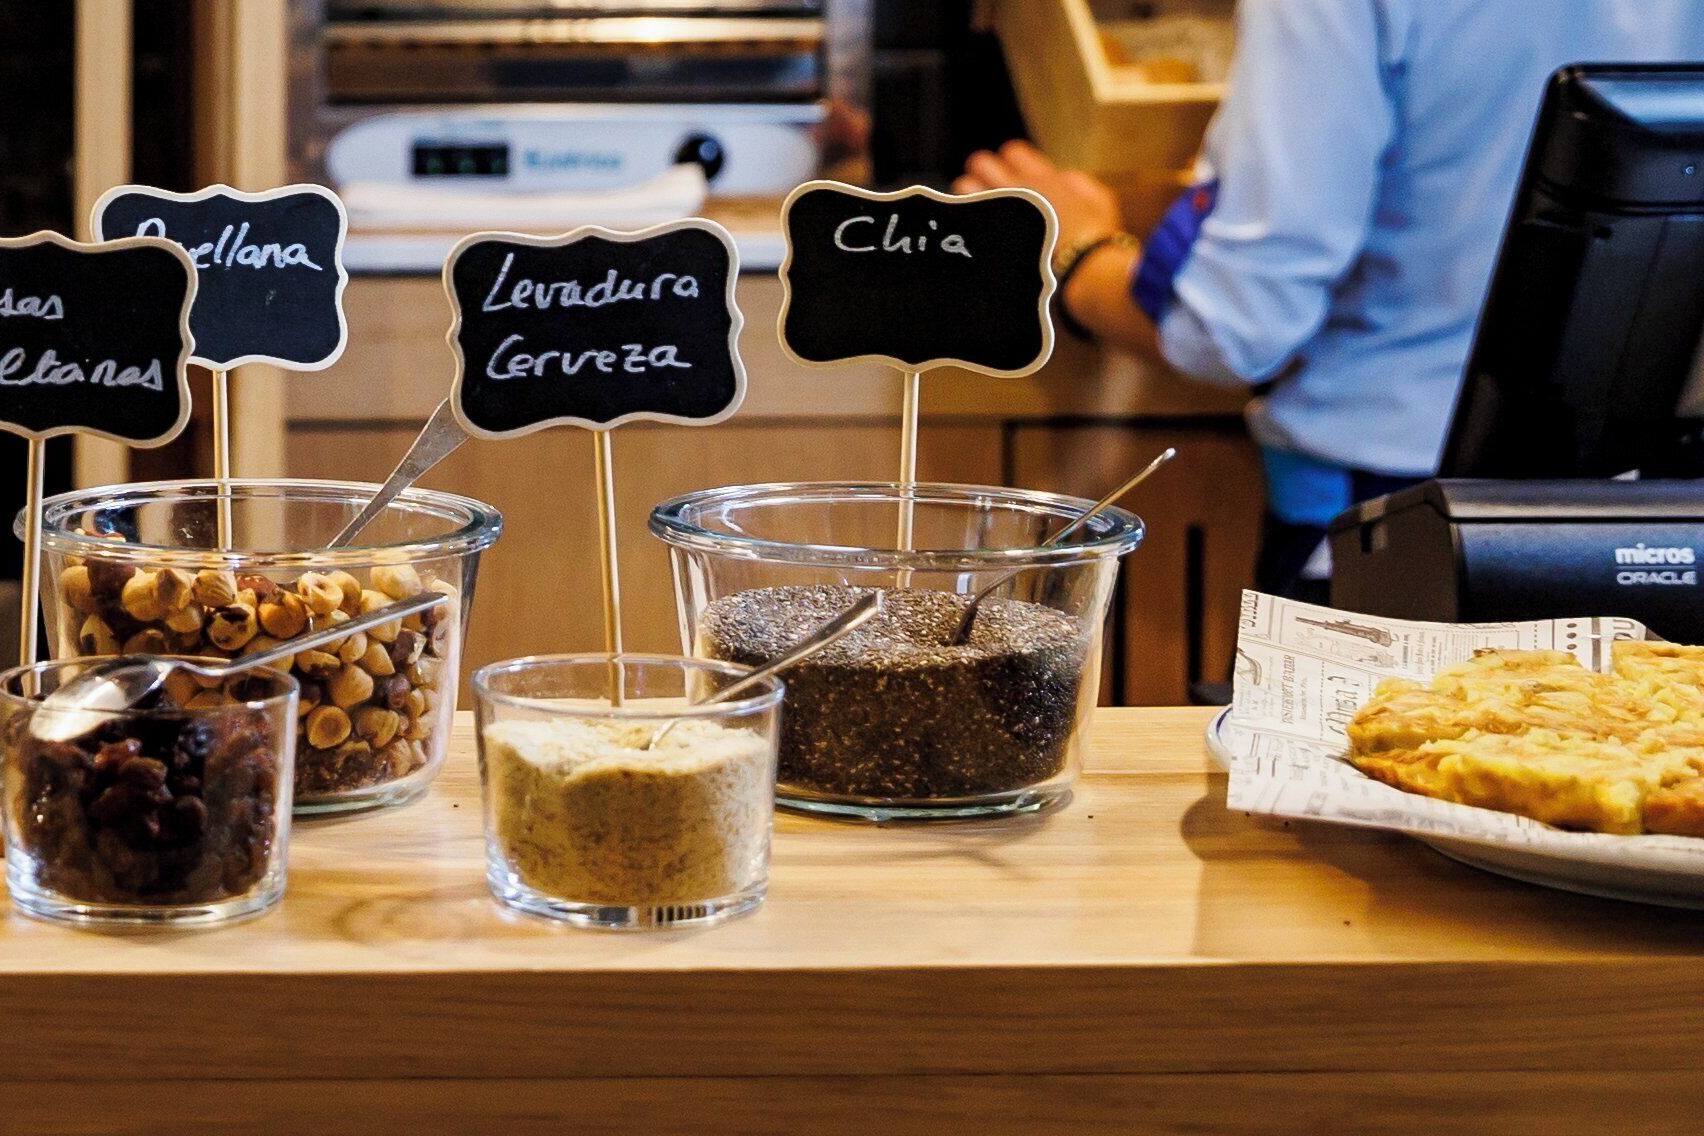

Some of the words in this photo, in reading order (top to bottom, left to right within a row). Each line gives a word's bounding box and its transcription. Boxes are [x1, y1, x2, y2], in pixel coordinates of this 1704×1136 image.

[136, 217, 323, 271] ellana
[834, 214, 972, 257] Chia
[483, 253, 699, 311] Levadura
[487, 334, 692, 379] Cerveza
[1615, 543, 1695, 564] micros
[1616, 571, 1697, 585] ORACLE
